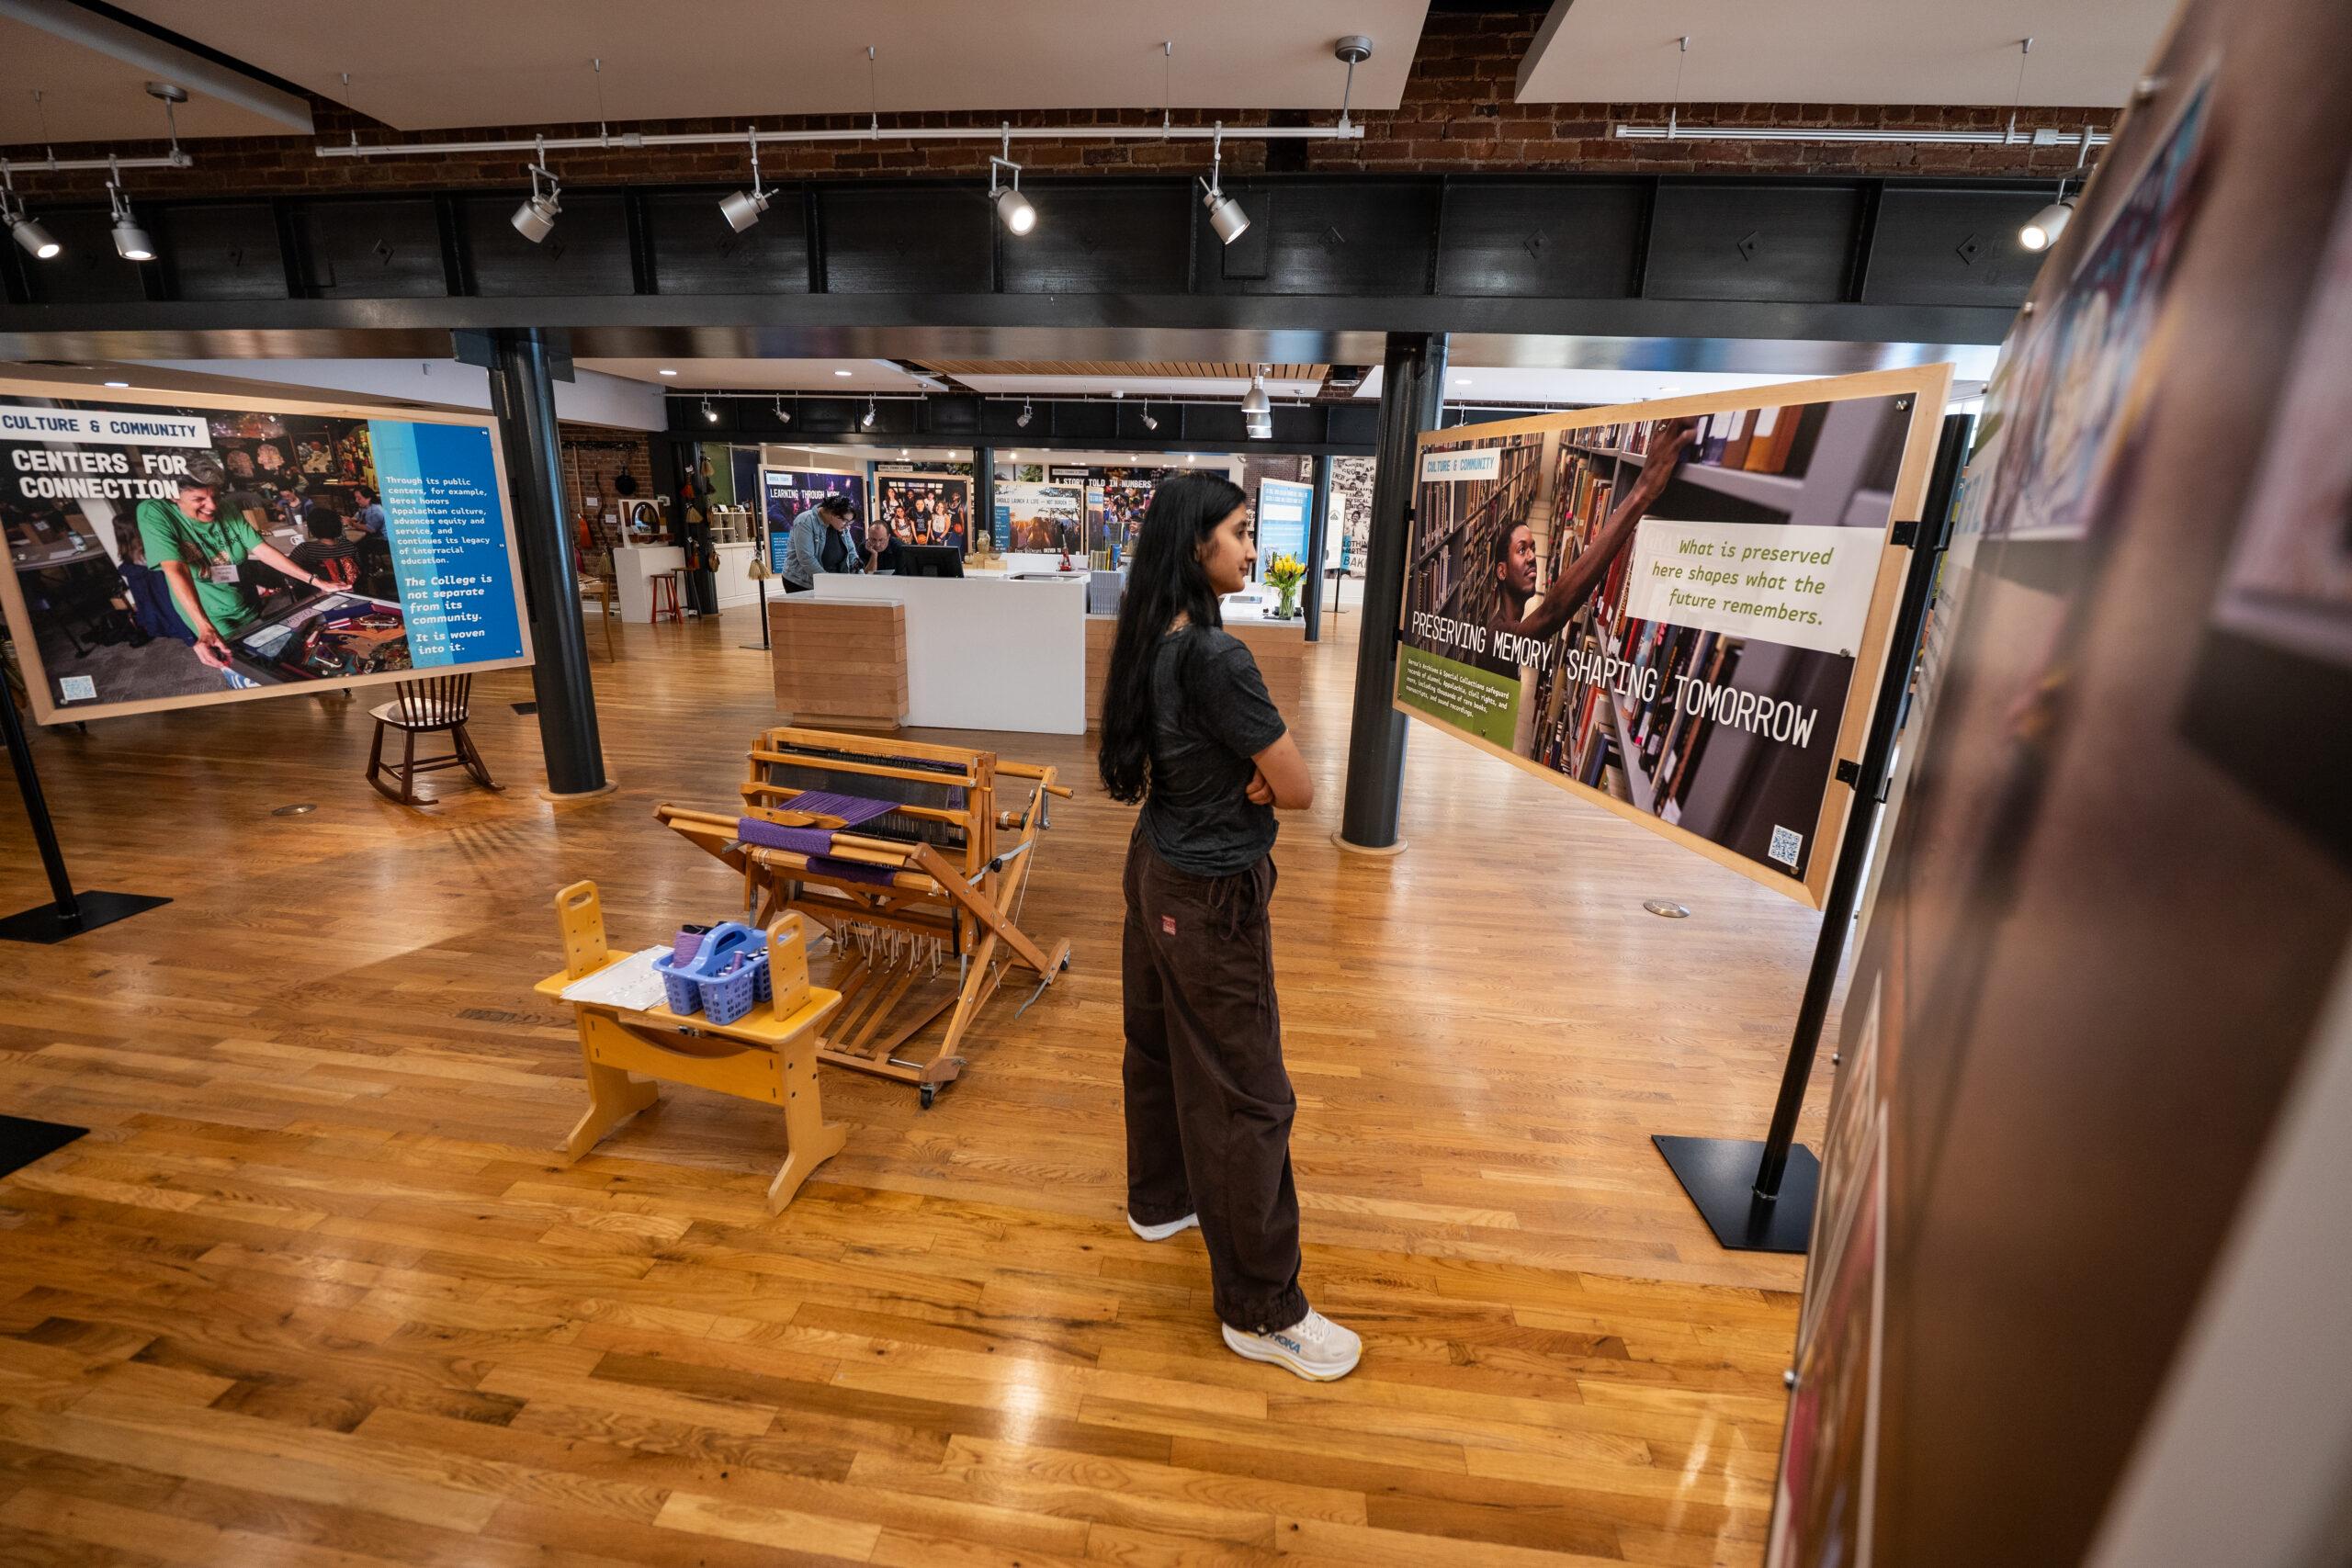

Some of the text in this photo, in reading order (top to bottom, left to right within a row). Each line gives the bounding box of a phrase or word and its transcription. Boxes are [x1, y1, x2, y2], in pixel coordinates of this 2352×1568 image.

[3, 415, 197, 437] CULTURE & COMMUNITY
[11, 449, 189, 475] CENTERS FOR
[1427, 457, 1495, 473] CULTURE & COMMUNITY
[18, 476, 181, 500] CONNECTION
[386, 477, 471, 486] Through its public
[1089, 479, 1105, 487] TOLD
[1110, 479, 1118, 488] IN
[1121, 480, 1151, 489] NUMBERS
[448, 488, 487, 497] example,
[770, 488, 799, 499] LEARNING
[801, 489, 825, 500] THROUGH
[391, 507, 487, 515] Appalachian culture,
[438, 517, 467, 525] equity
[395, 526, 453, 536] service, and
[397, 536, 442, 545] continues
[461, 536, 491, 545] legacy
[399, 546, 465, 555] of interracial
[1679, 539, 1714, 557] What
[1721, 541, 1736, 558] is
[1741, 547, 1835, 566] preserved
[401, 557, 449, 565] education.
[1343, 556, 1366, 569] BAK
[404, 574, 492, 587] The College is
[1652, 561, 1826, 595] here shapes what the
[407, 588, 485, 599] not separate
[410, 601, 462, 614] from its
[1668, 588, 1823, 626] future remembers.
[413, 613, 482, 625] community.
[415, 629, 485, 642] It is woven
[418, 643, 465, 655] into it.
[1412, 611, 1818, 750] PRESERVING MEMORY, SHAPING TOMORROW
[1422, 662, 1439, 674] Archives
[1443, 670, 1459, 682] Special
[1459, 676, 1485, 691] Collections
[1486, 687, 1510, 700] safeguard
[1406, 677, 1487, 713] more, including thousands of rare books,
[1407, 668, 1421, 677] records
[1427, 673, 1442, 685] alumni,
[1443, 680, 1466, 694] Appalachia,
[1468, 690, 1480, 699] civil
[1481, 694, 1497, 706] rights,
[1498, 702, 1508, 710] and
[1406, 685, 1429, 700] manuscripts,
[1438, 697, 1449, 707] sound
[1450, 703, 1474, 717] recordings.
[1269, 1332, 1301, 1354] HOKA
